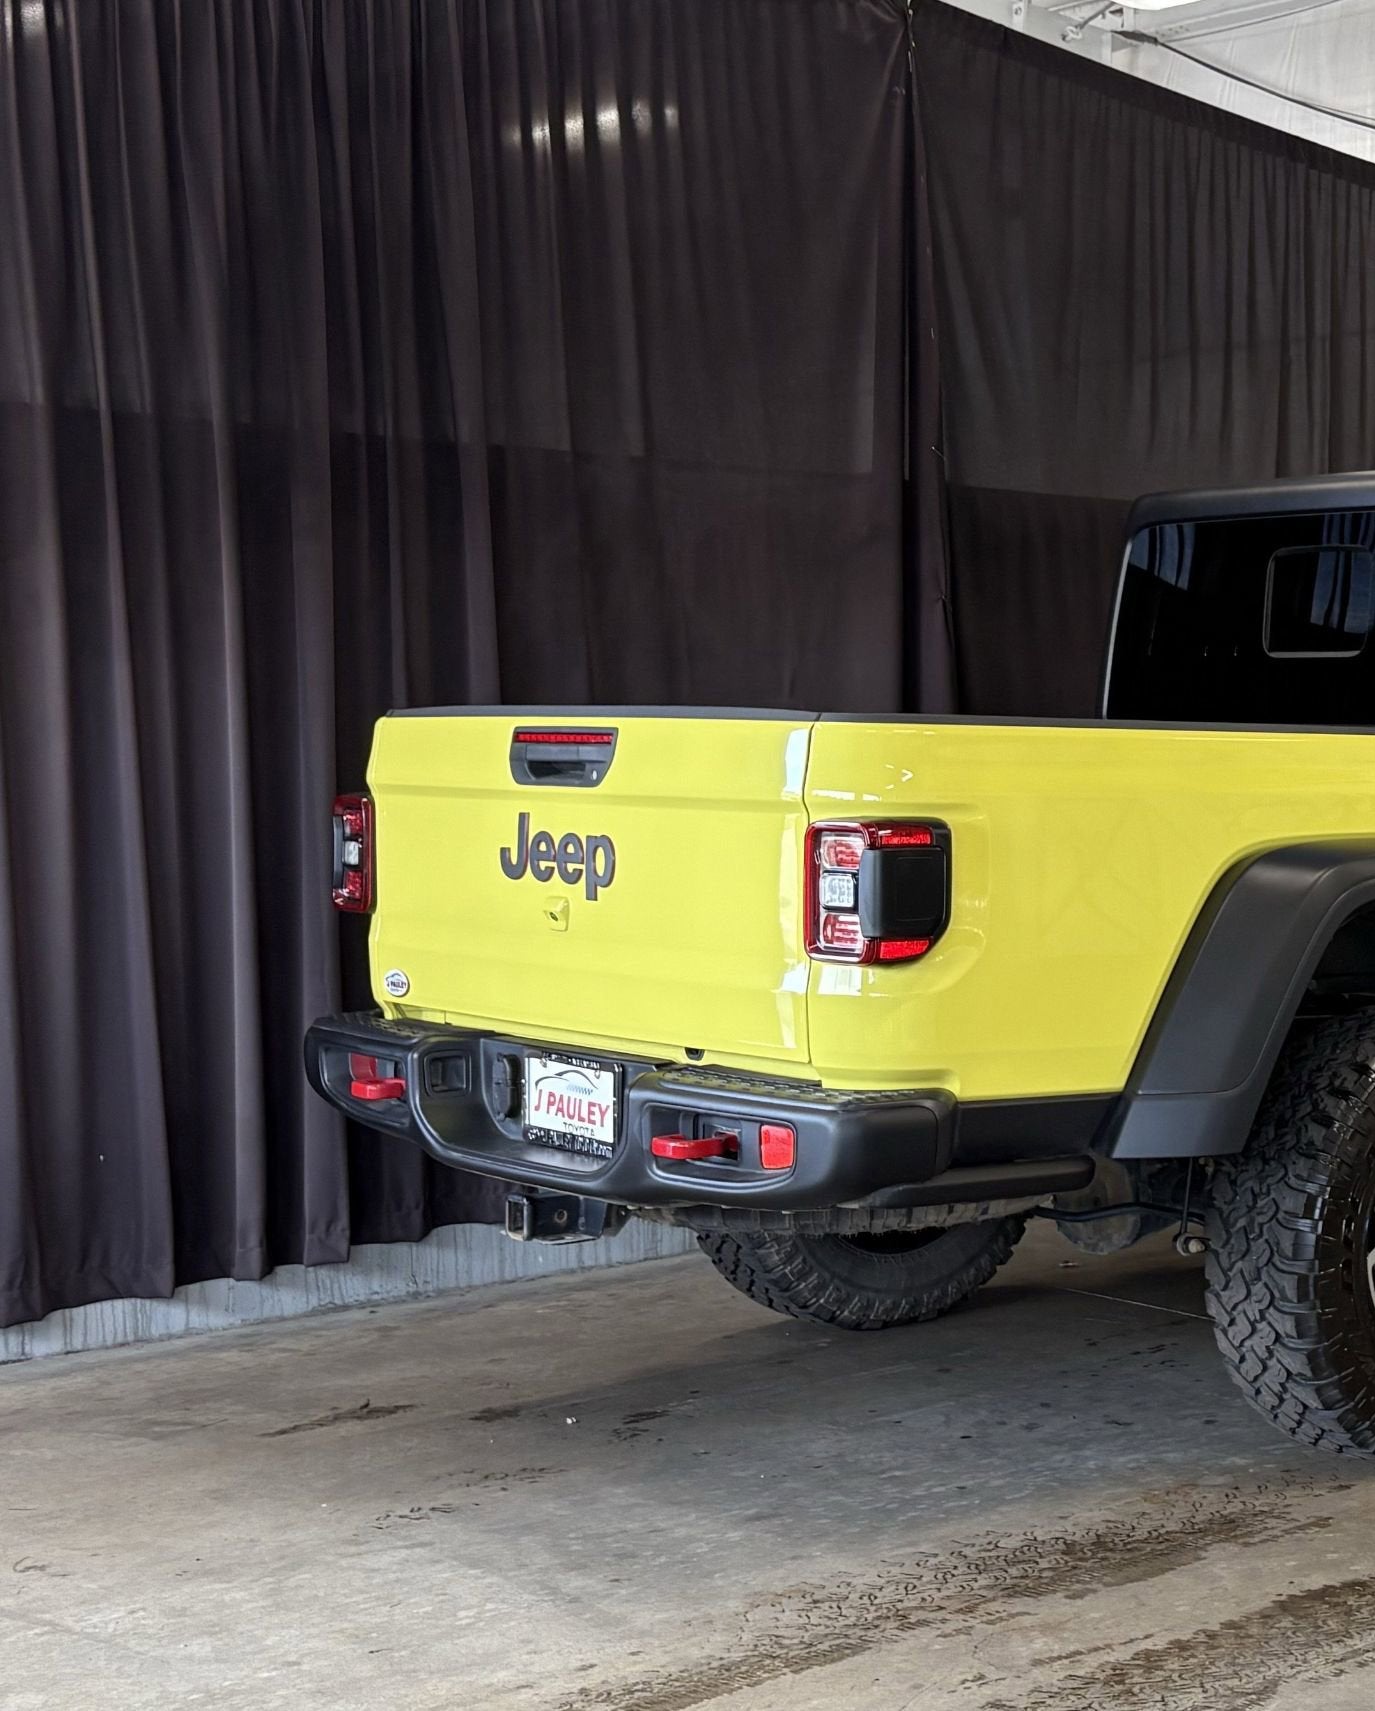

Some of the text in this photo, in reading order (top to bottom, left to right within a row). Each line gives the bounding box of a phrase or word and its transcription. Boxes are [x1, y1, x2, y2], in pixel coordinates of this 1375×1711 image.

[500, 812, 616, 902] Jeep
[534, 1089, 610, 1128] J PAULEY
[563, 1121, 595, 1137] TOYOTA
